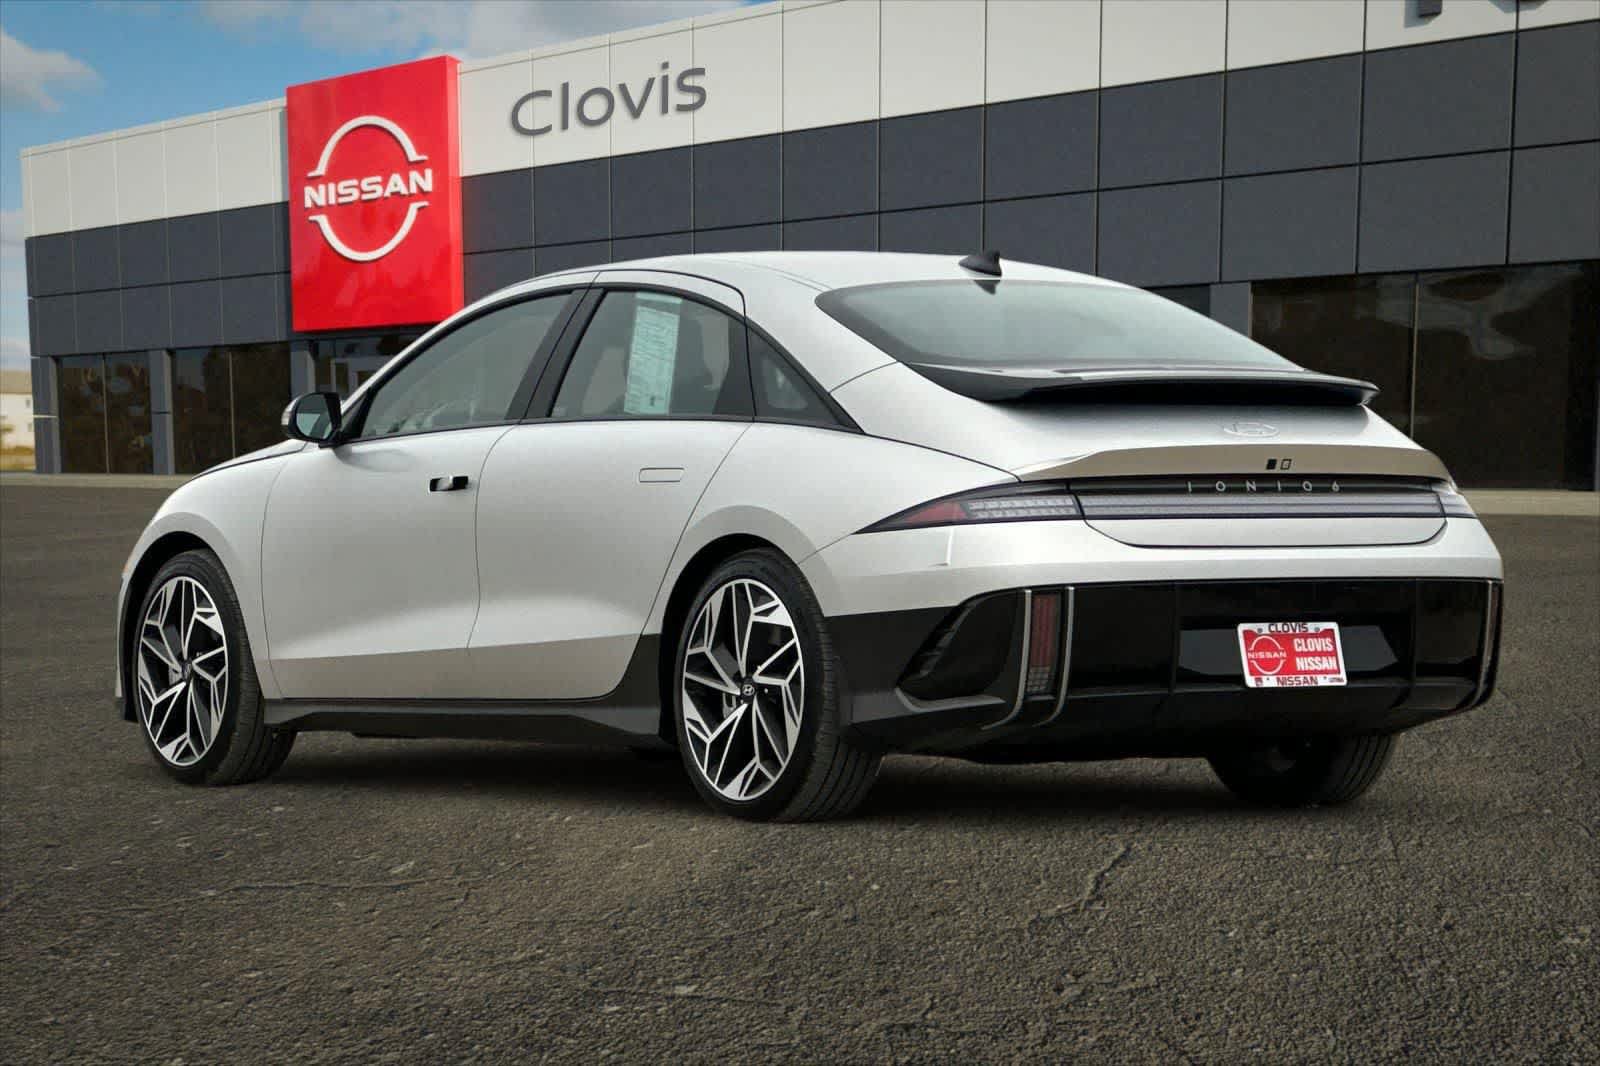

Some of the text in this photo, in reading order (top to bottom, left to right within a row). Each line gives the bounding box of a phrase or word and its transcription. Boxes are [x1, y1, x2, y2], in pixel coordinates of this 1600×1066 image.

[511, 62, 708, 136] Clovis
[304, 169, 433, 208] NISSAN
[1268, 623, 1309, 633] CLOVIS
[1295, 638, 1334, 652] CLOVIS
[1247, 651, 1287, 659] NISSAN
[1296, 656, 1337, 671] NISSAN
[1276, 676, 1318, 686] NISSAN
